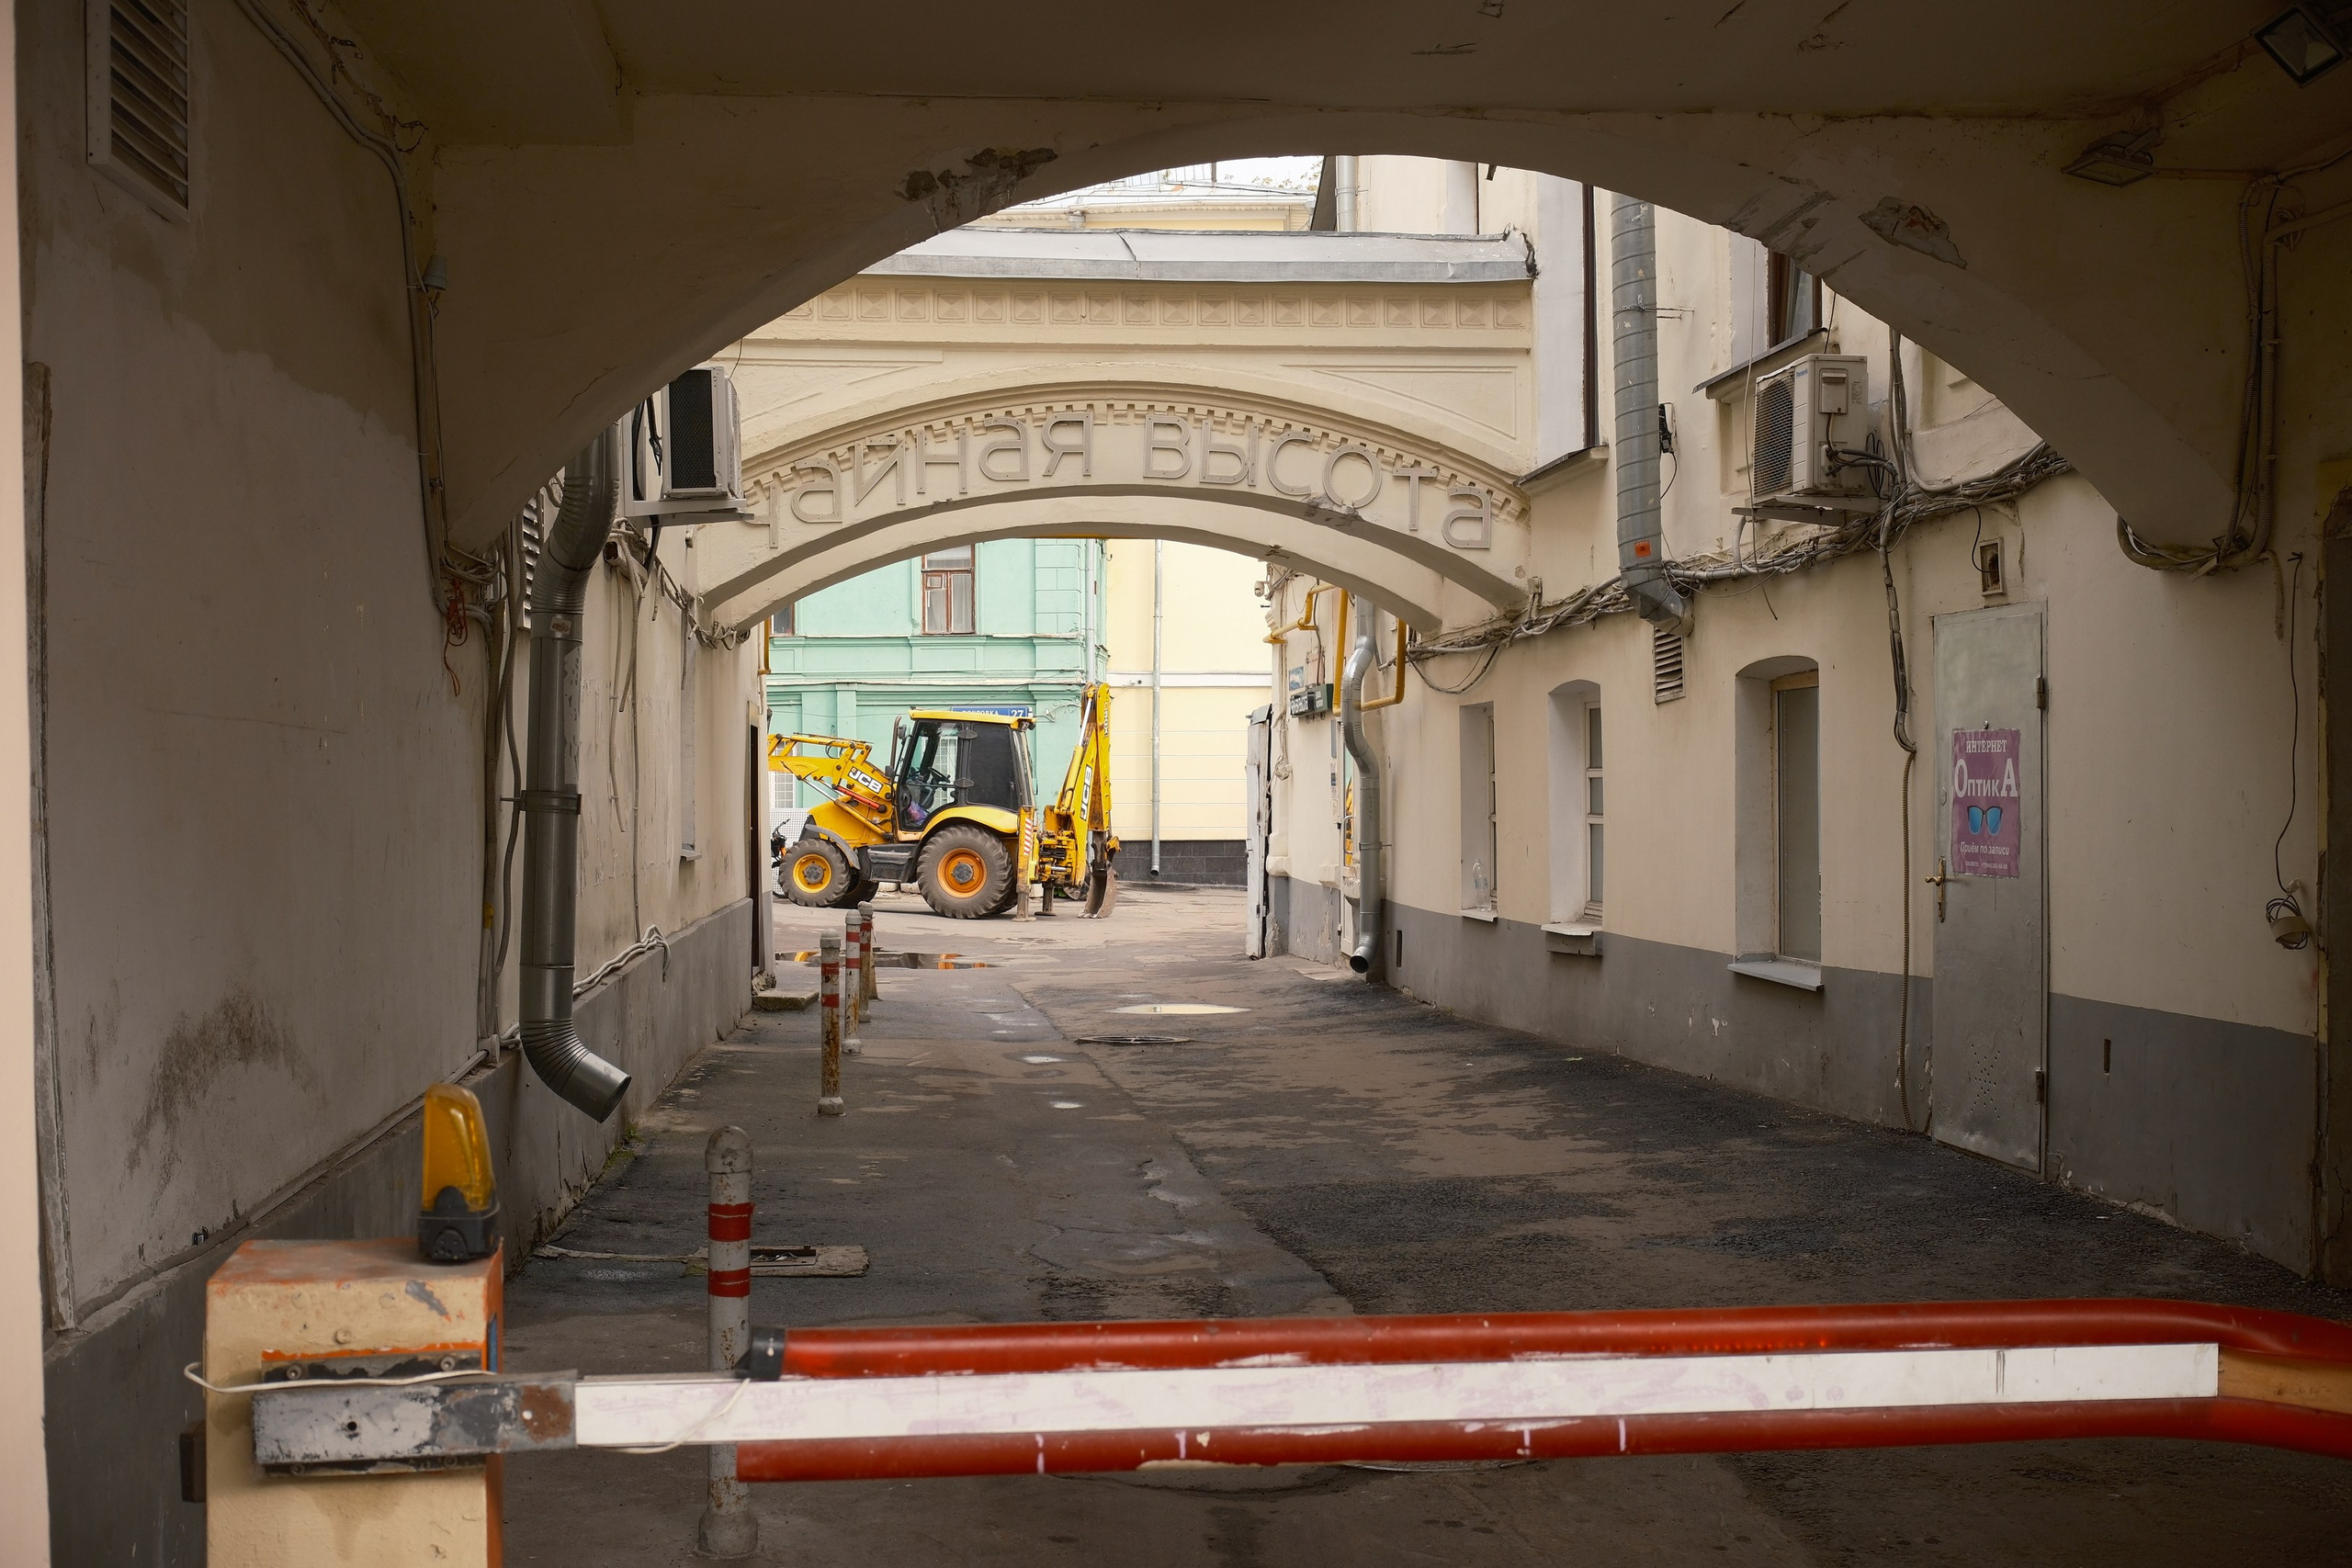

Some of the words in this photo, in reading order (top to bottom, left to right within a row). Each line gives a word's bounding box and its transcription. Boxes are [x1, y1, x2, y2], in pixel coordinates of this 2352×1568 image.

[1011, 709, 1024, 717] 27
[1965, 739, 2007, 753] ИНТЕРНЕТ
[848, 766, 883, 794] JCB
[1080, 764, 1092, 821] JCB
[1960, 841, 1979, 855] Приём
[1979, 845, 1988, 854] по
[1988, 845, 2010, 855] записи
